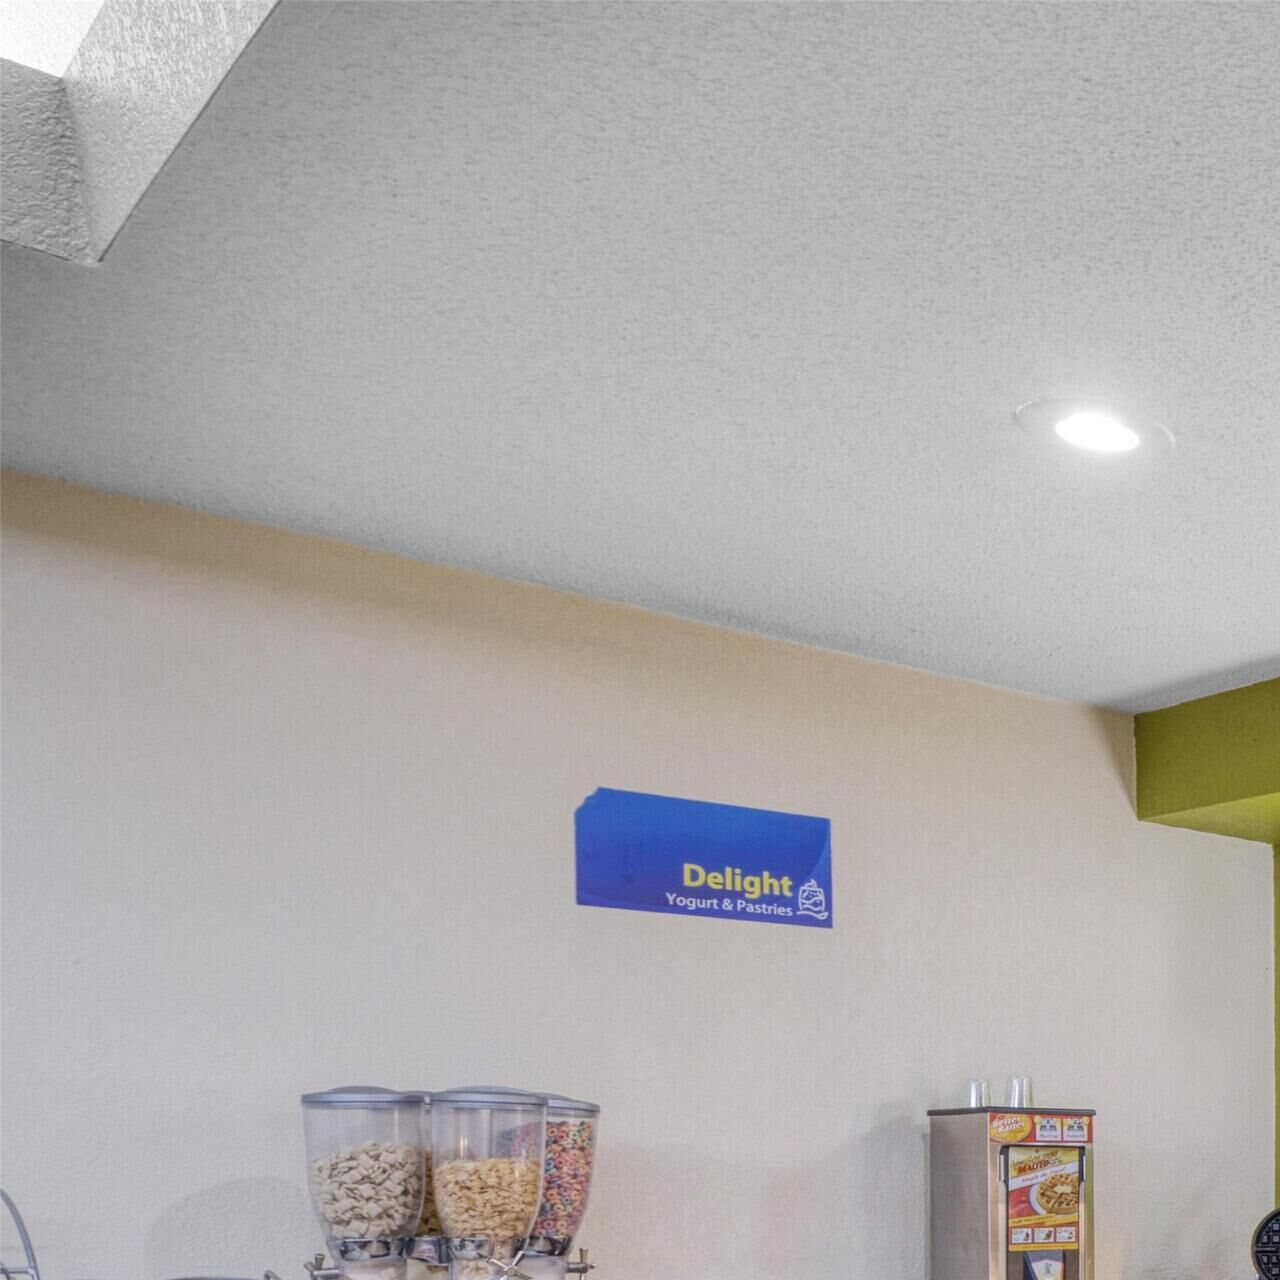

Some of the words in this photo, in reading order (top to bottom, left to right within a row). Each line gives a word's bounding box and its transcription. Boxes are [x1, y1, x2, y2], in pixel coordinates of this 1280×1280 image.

[683, 863, 792, 899] Delight
[665, 892, 719, 910] Yogurt
[722, 898, 734, 911] &
[737, 899, 793, 917] Pastries
